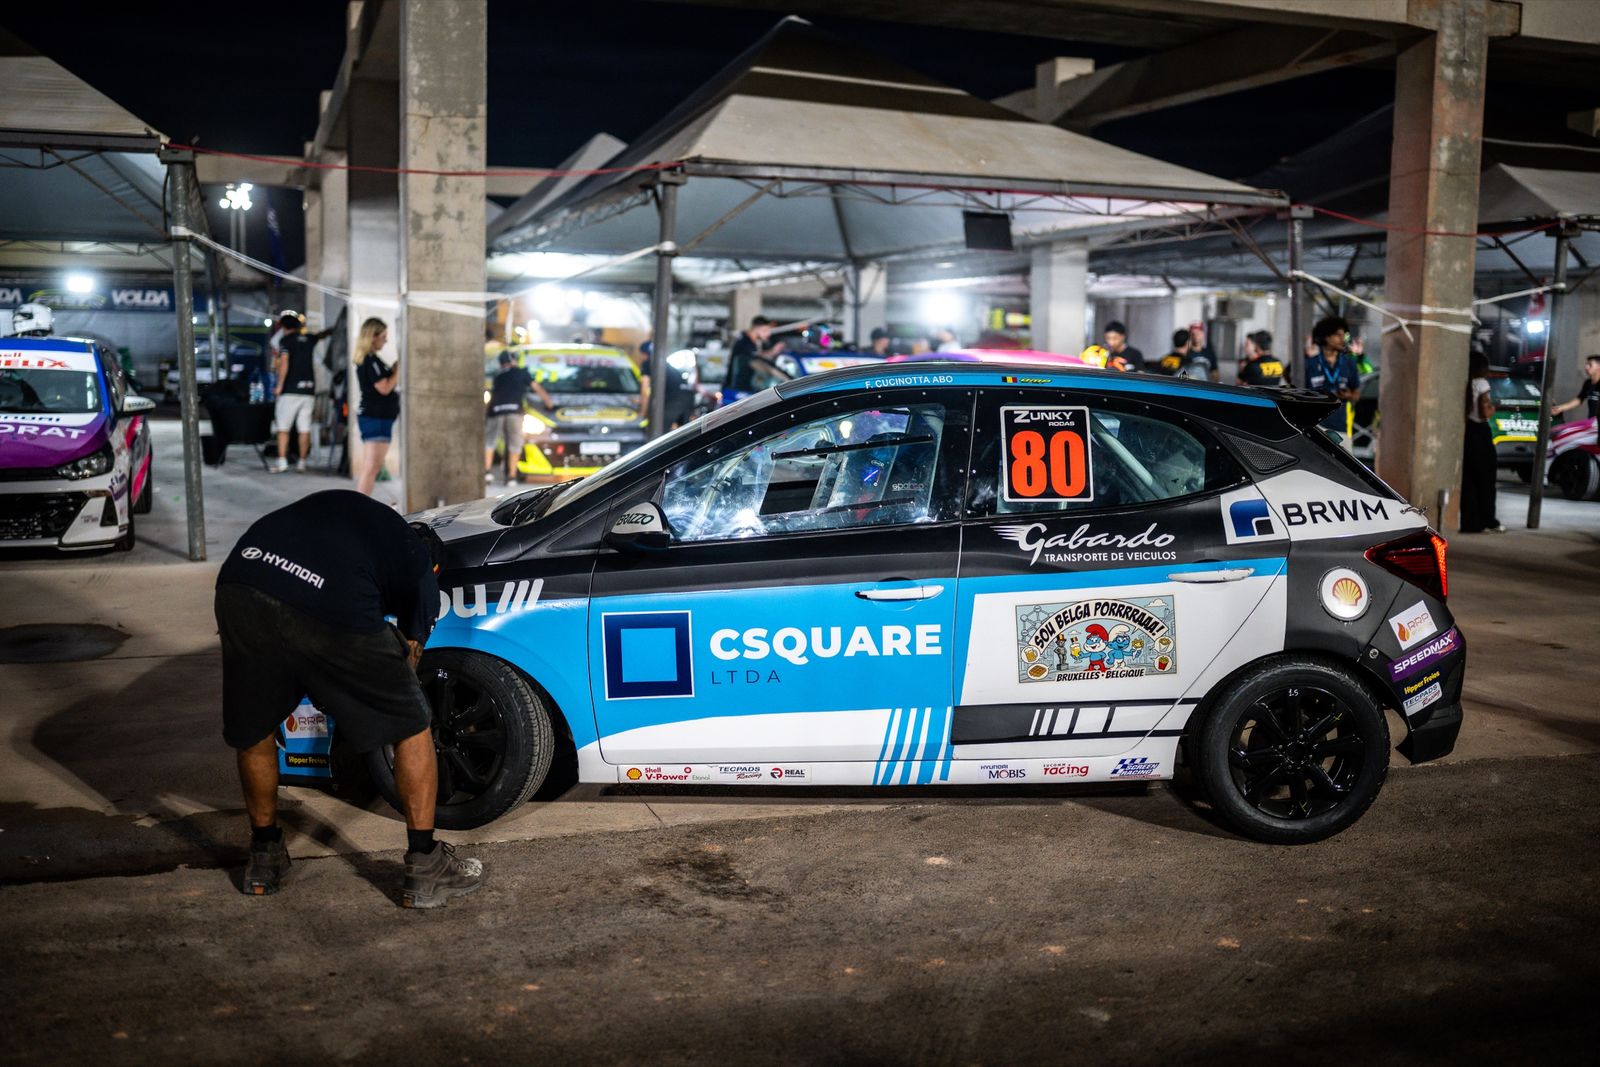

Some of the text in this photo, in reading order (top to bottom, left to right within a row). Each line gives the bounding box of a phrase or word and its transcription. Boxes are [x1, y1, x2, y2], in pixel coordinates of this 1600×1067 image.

[112, 290, 169, 306] VOLDA
[865, 375, 953, 389] F. CUCINOTTA ABO
[1013, 410, 1073, 424] ZUNKY
[1011, 430, 1086, 497] 80
[1282, 499, 1390, 526] BRWM
[1014, 522, 1176, 567] Gabardo
[1044, 551, 1177, 562] TRANSPORTE DE VEICULOS
[262, 551, 325, 589] HYUNDAI
[1034, 624, 1056, 649] SOU
[1055, 604, 1091, 630] BELGA
[709, 624, 942, 666] CSQUARE
[1394, 634, 1453, 674] SPEEDMAX
[711, 669, 781, 685] LTDA
[1056, 668, 1145, 682] BRUXELLES BELGIQUE
[1404, 684, 1438, 707] TECPADS
[645, 773, 689, 781] V-Power
[988, 768, 1026, 779] MOBIS
[1043, 764, 1090, 777] racing
